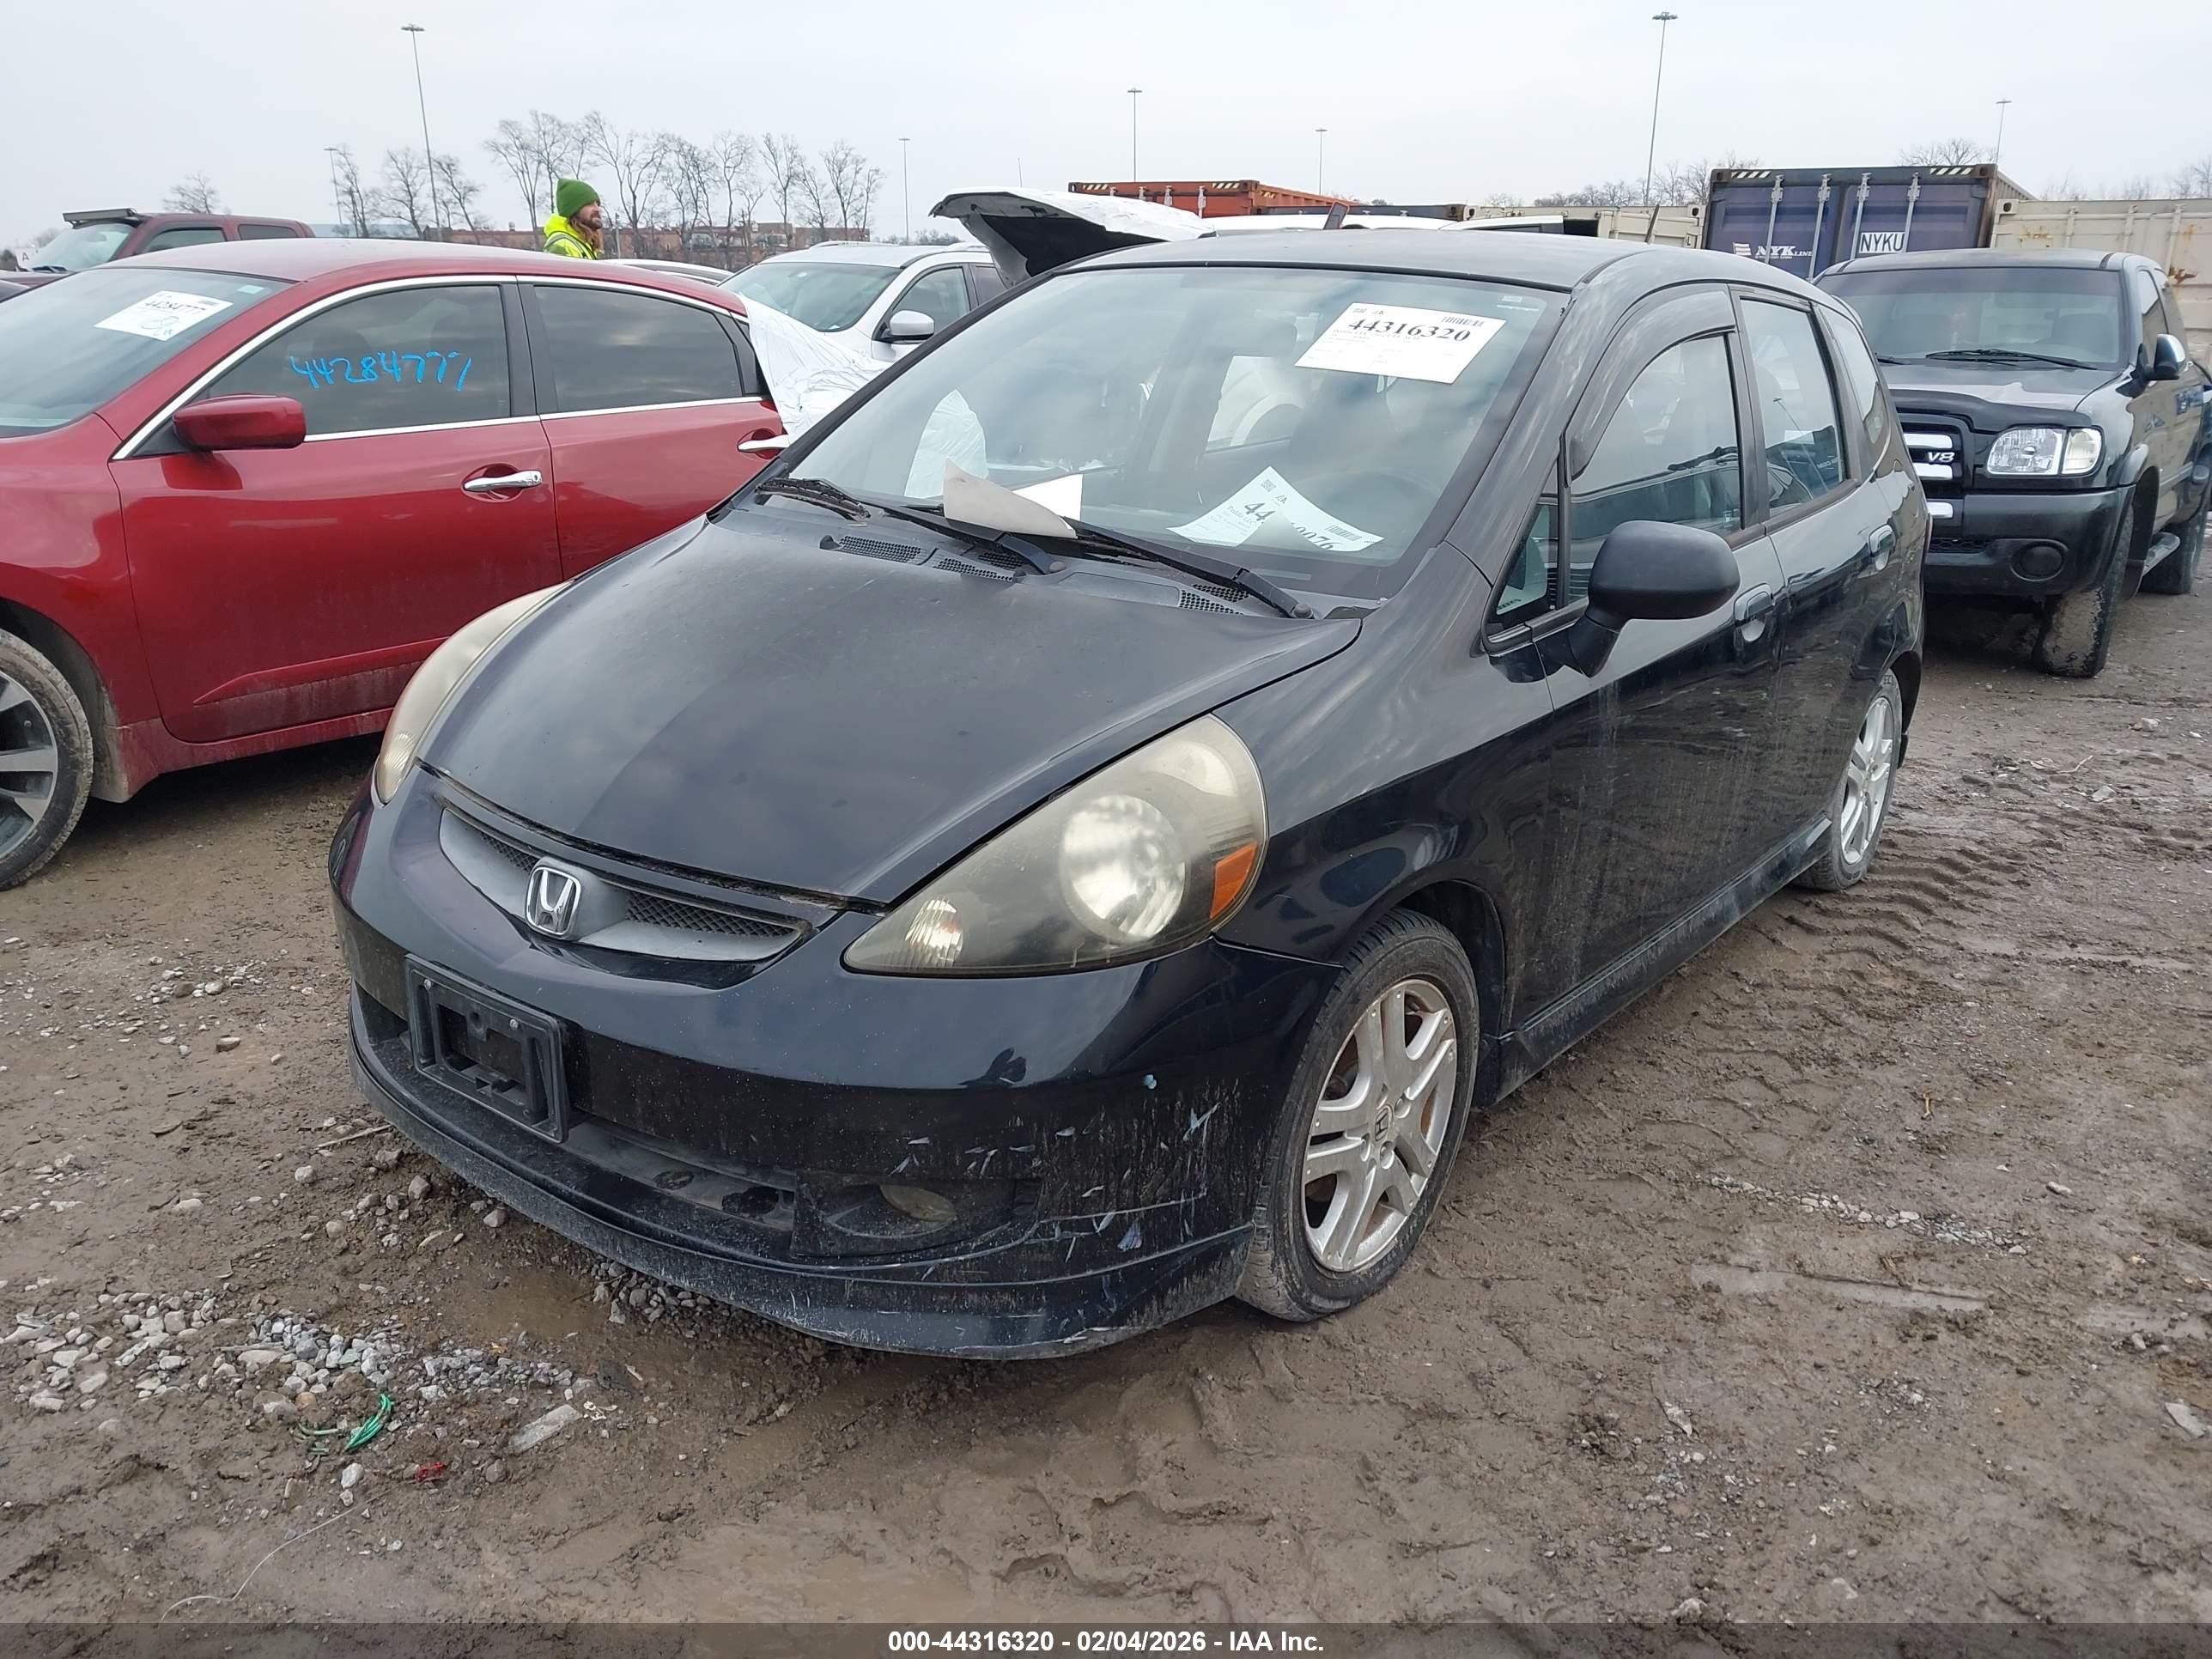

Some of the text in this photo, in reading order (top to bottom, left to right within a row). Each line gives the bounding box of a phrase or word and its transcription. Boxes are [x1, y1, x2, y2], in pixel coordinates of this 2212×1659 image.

[1860, 233, 1905, 252] NYKU
[1755, 245, 1796, 256] NYK
[1347, 318, 1471, 342] 44316320
[1927, 451, 1955, 463] V8
